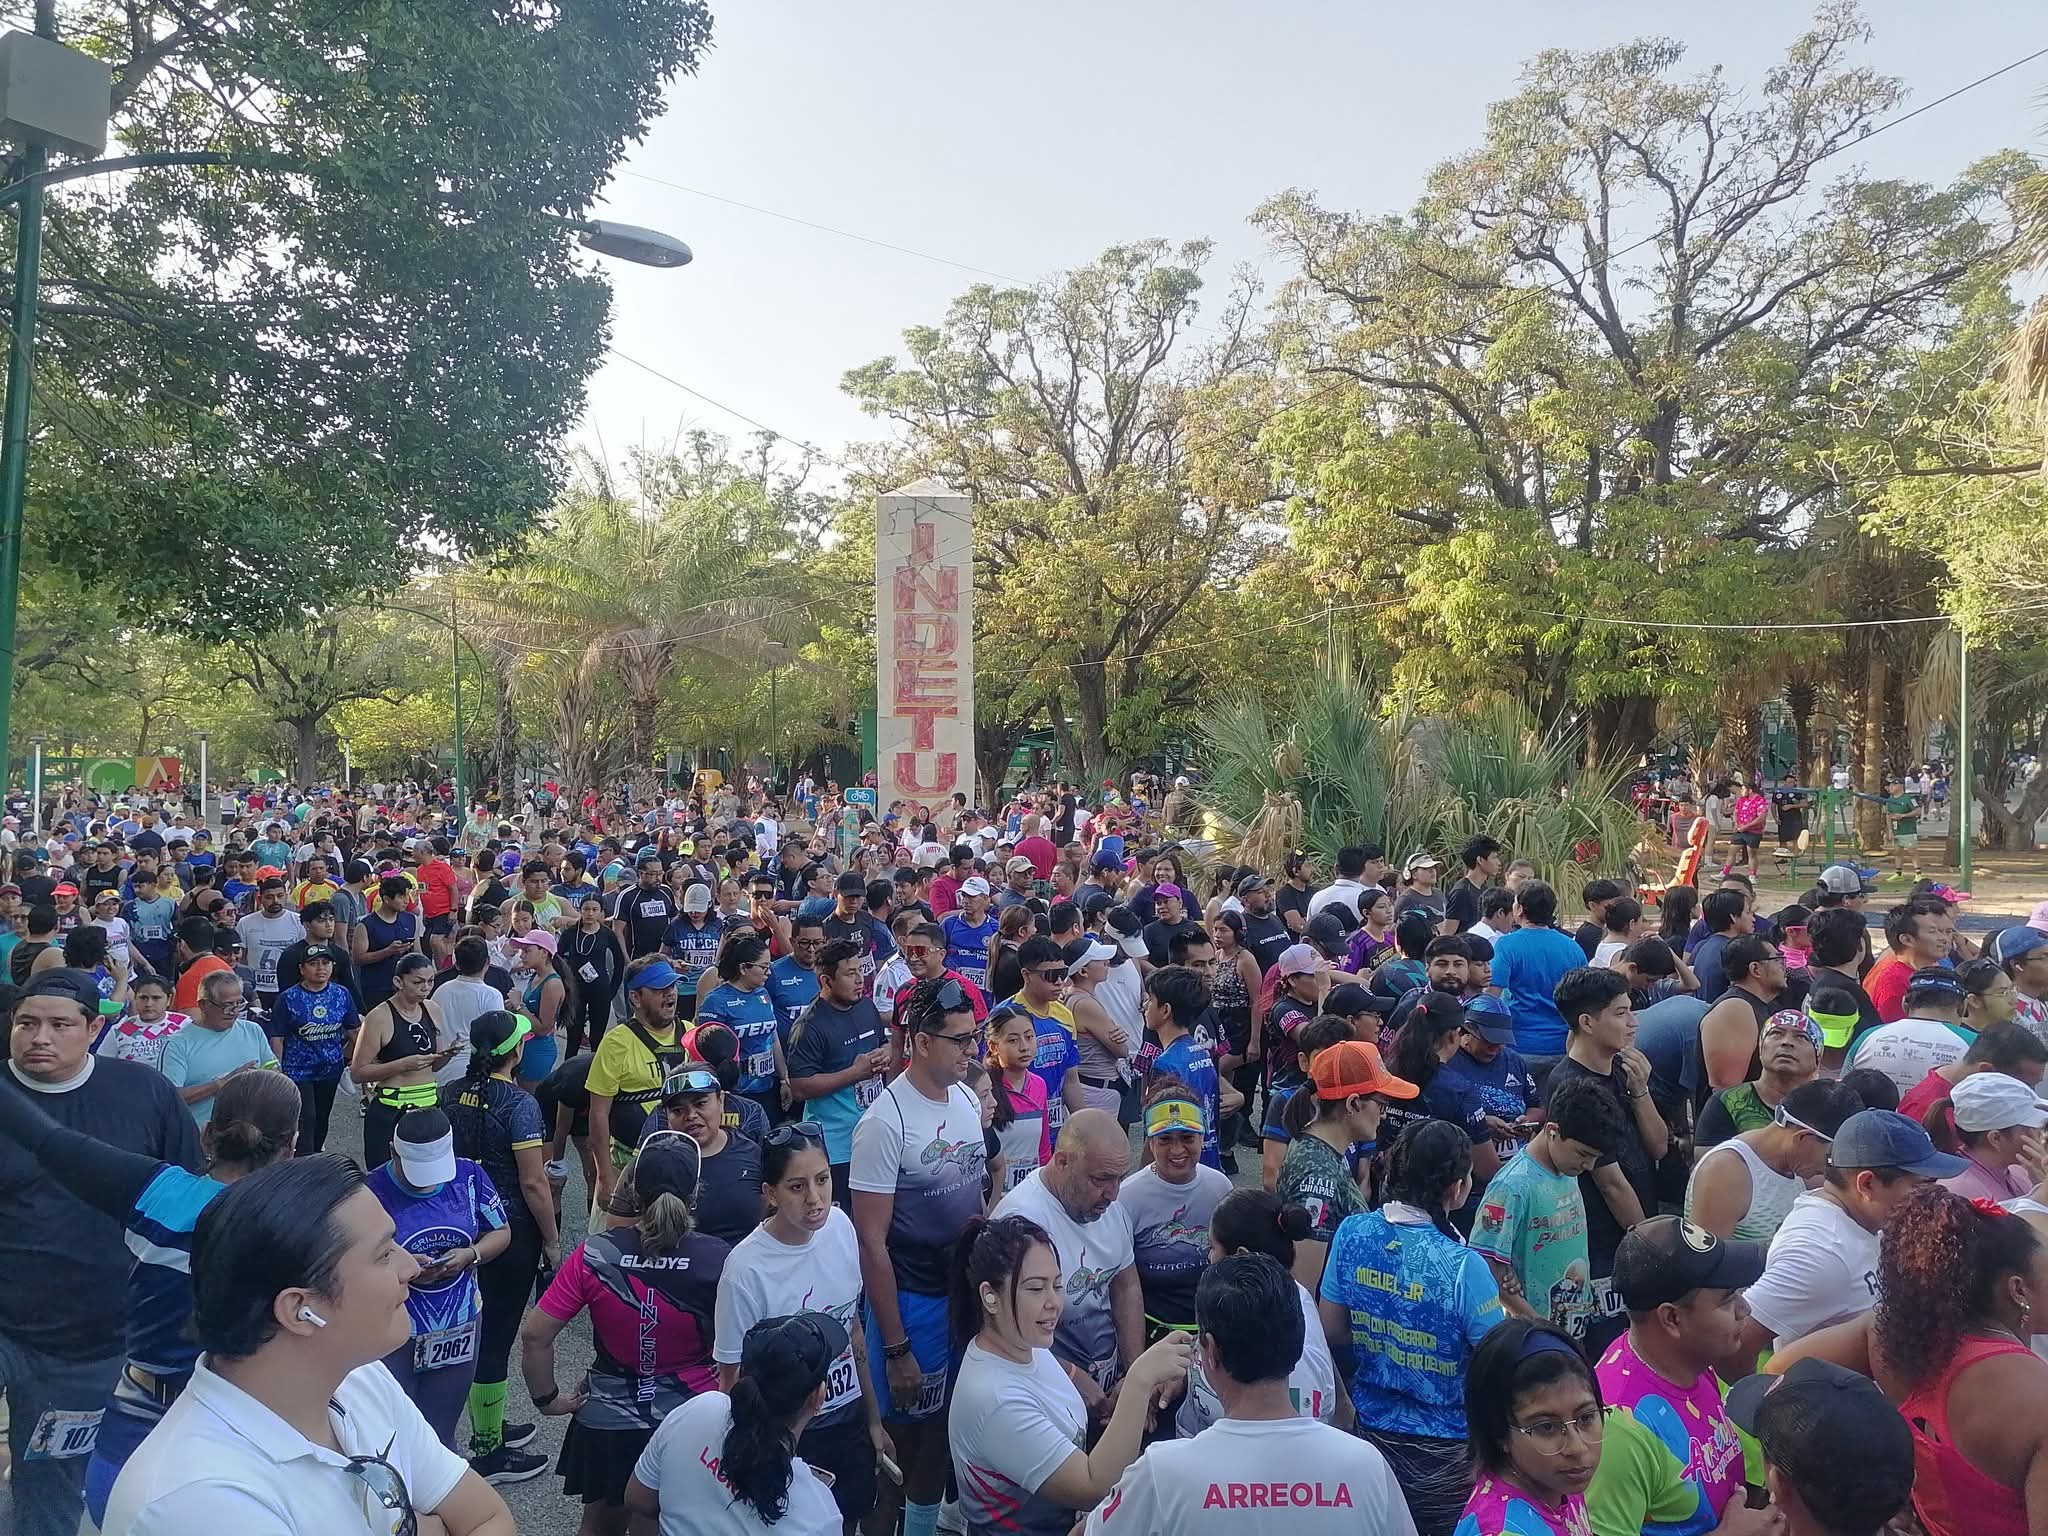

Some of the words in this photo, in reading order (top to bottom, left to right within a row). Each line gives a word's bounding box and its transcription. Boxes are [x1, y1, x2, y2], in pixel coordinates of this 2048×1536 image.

[620, 1254, 690, 1270] GLADYS
[1356, 1265, 1401, 1296] MIGUEL
[1403, 1282, 1425, 1303] JR
[431, 1335, 471, 1364] 2962
[1203, 1482, 1353, 1509] ARREOLA
